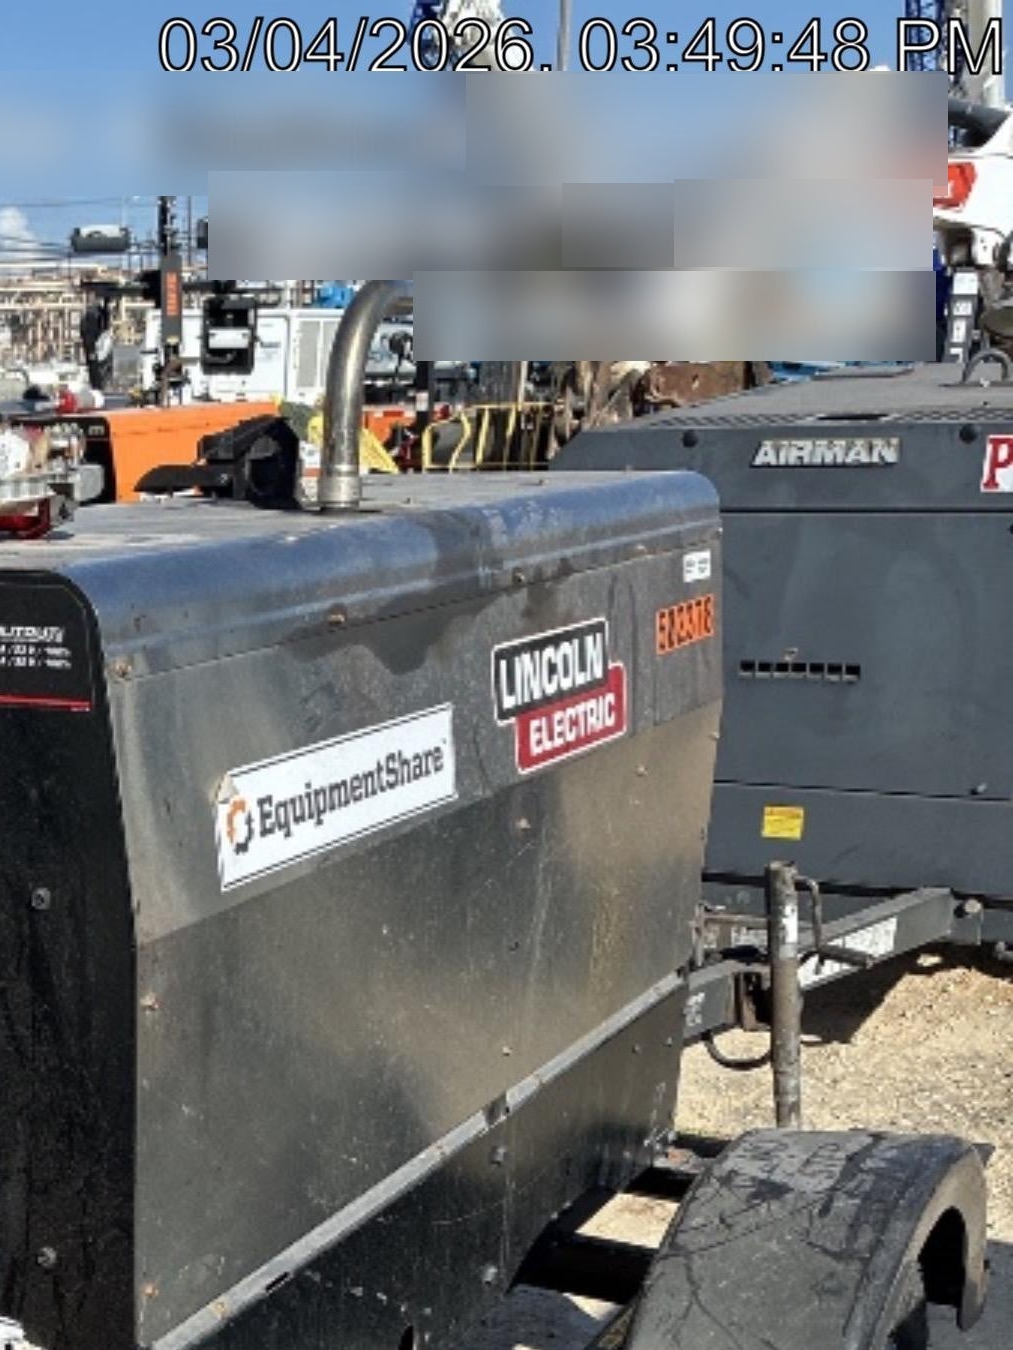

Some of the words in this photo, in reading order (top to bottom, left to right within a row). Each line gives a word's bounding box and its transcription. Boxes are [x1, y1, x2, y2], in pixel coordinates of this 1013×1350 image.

[751, 437, 899, 466] AIRMAN
[499, 632, 604, 710] LINCOLN
[529, 692, 616, 757] ELECTRIC
[257, 746, 444, 839] EquipmentShare
